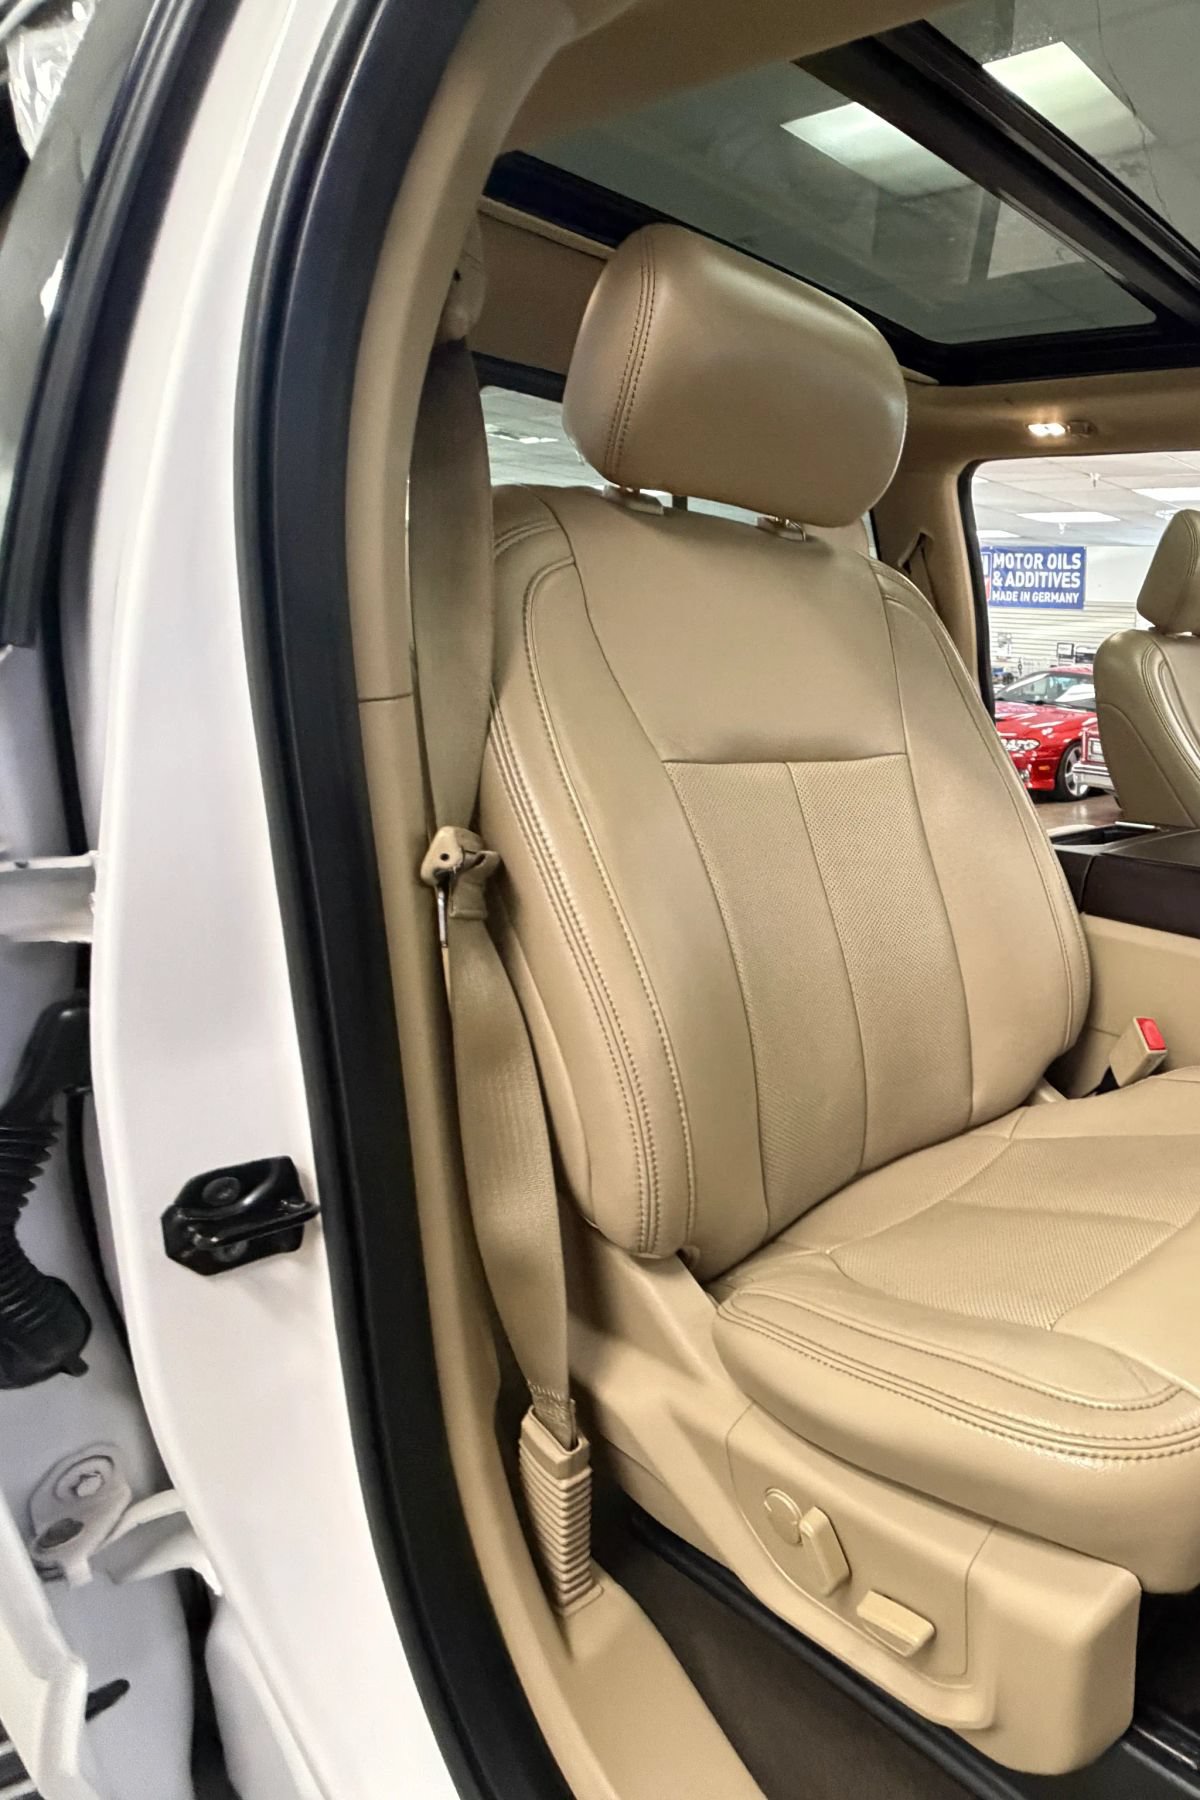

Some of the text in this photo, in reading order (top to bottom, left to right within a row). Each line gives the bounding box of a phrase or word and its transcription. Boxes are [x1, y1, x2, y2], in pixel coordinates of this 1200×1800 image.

[993, 553, 1044, 569] MOTOR
[1046, 553, 1082, 570] OILS
[992, 571, 1081, 588] & ADDITIVES
[992, 590, 1080, 604] MADE IN GERMANY
